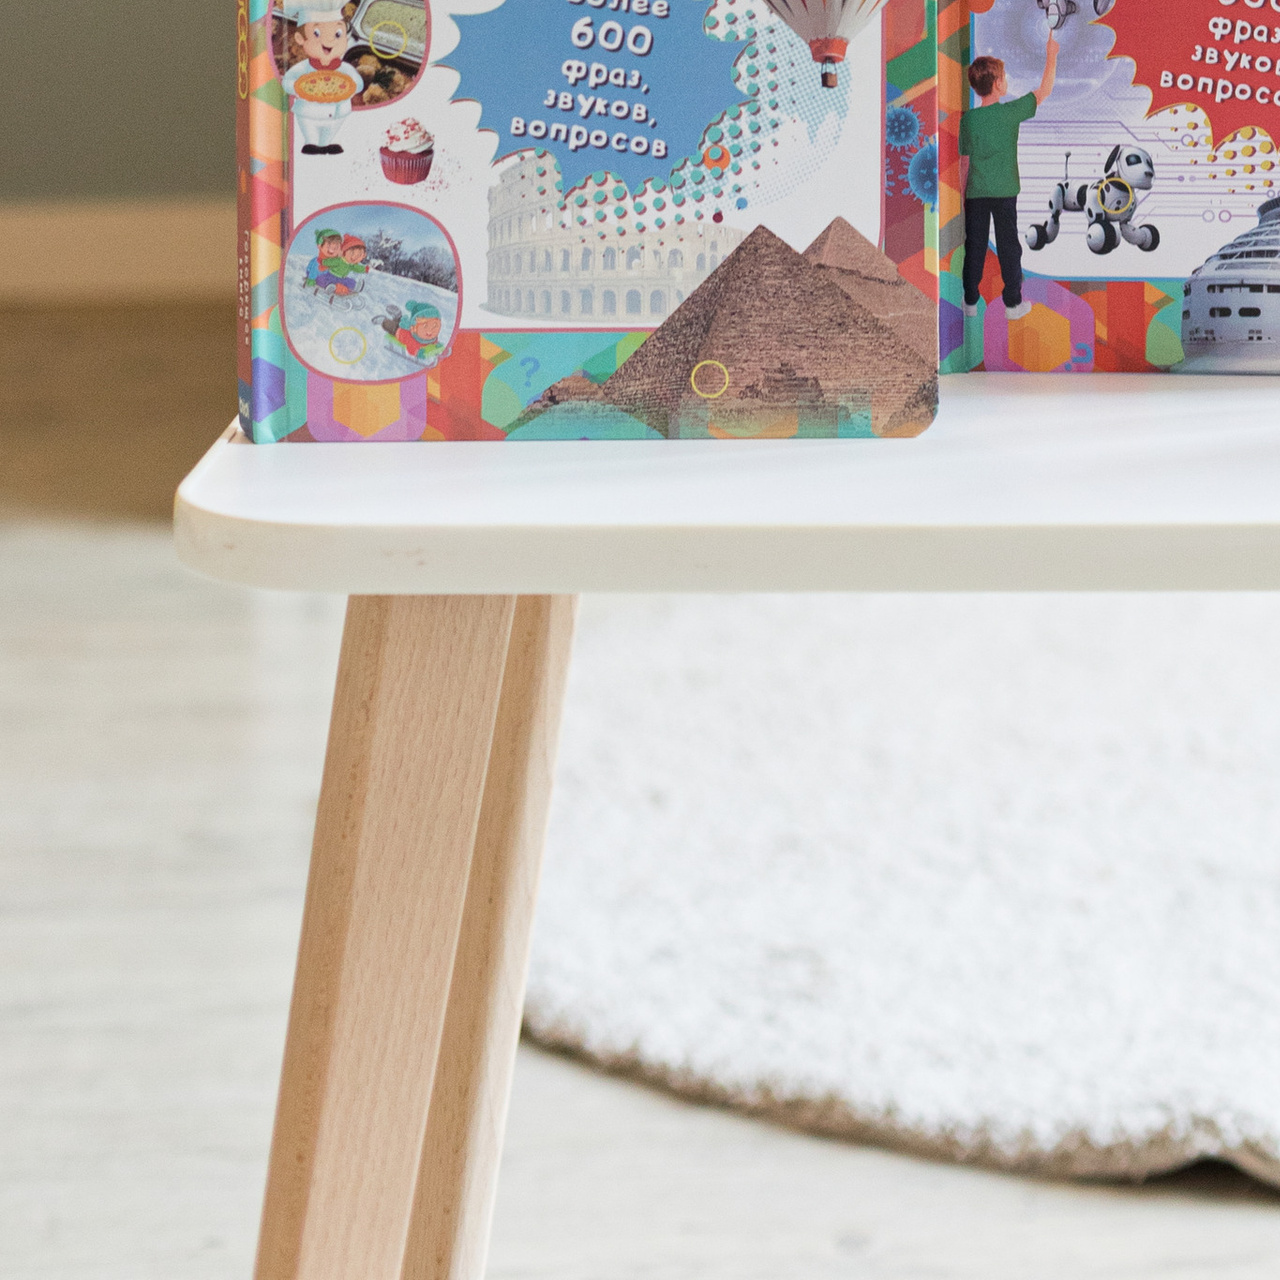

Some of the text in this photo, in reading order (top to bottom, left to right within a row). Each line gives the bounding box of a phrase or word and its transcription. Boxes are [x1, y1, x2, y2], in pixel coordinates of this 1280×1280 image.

[571, 16, 654, 57] 600
[561, 59, 650, 94] фраз,
[543, 89, 657, 128] звуков,
[510, 116, 669, 158] вопросов
